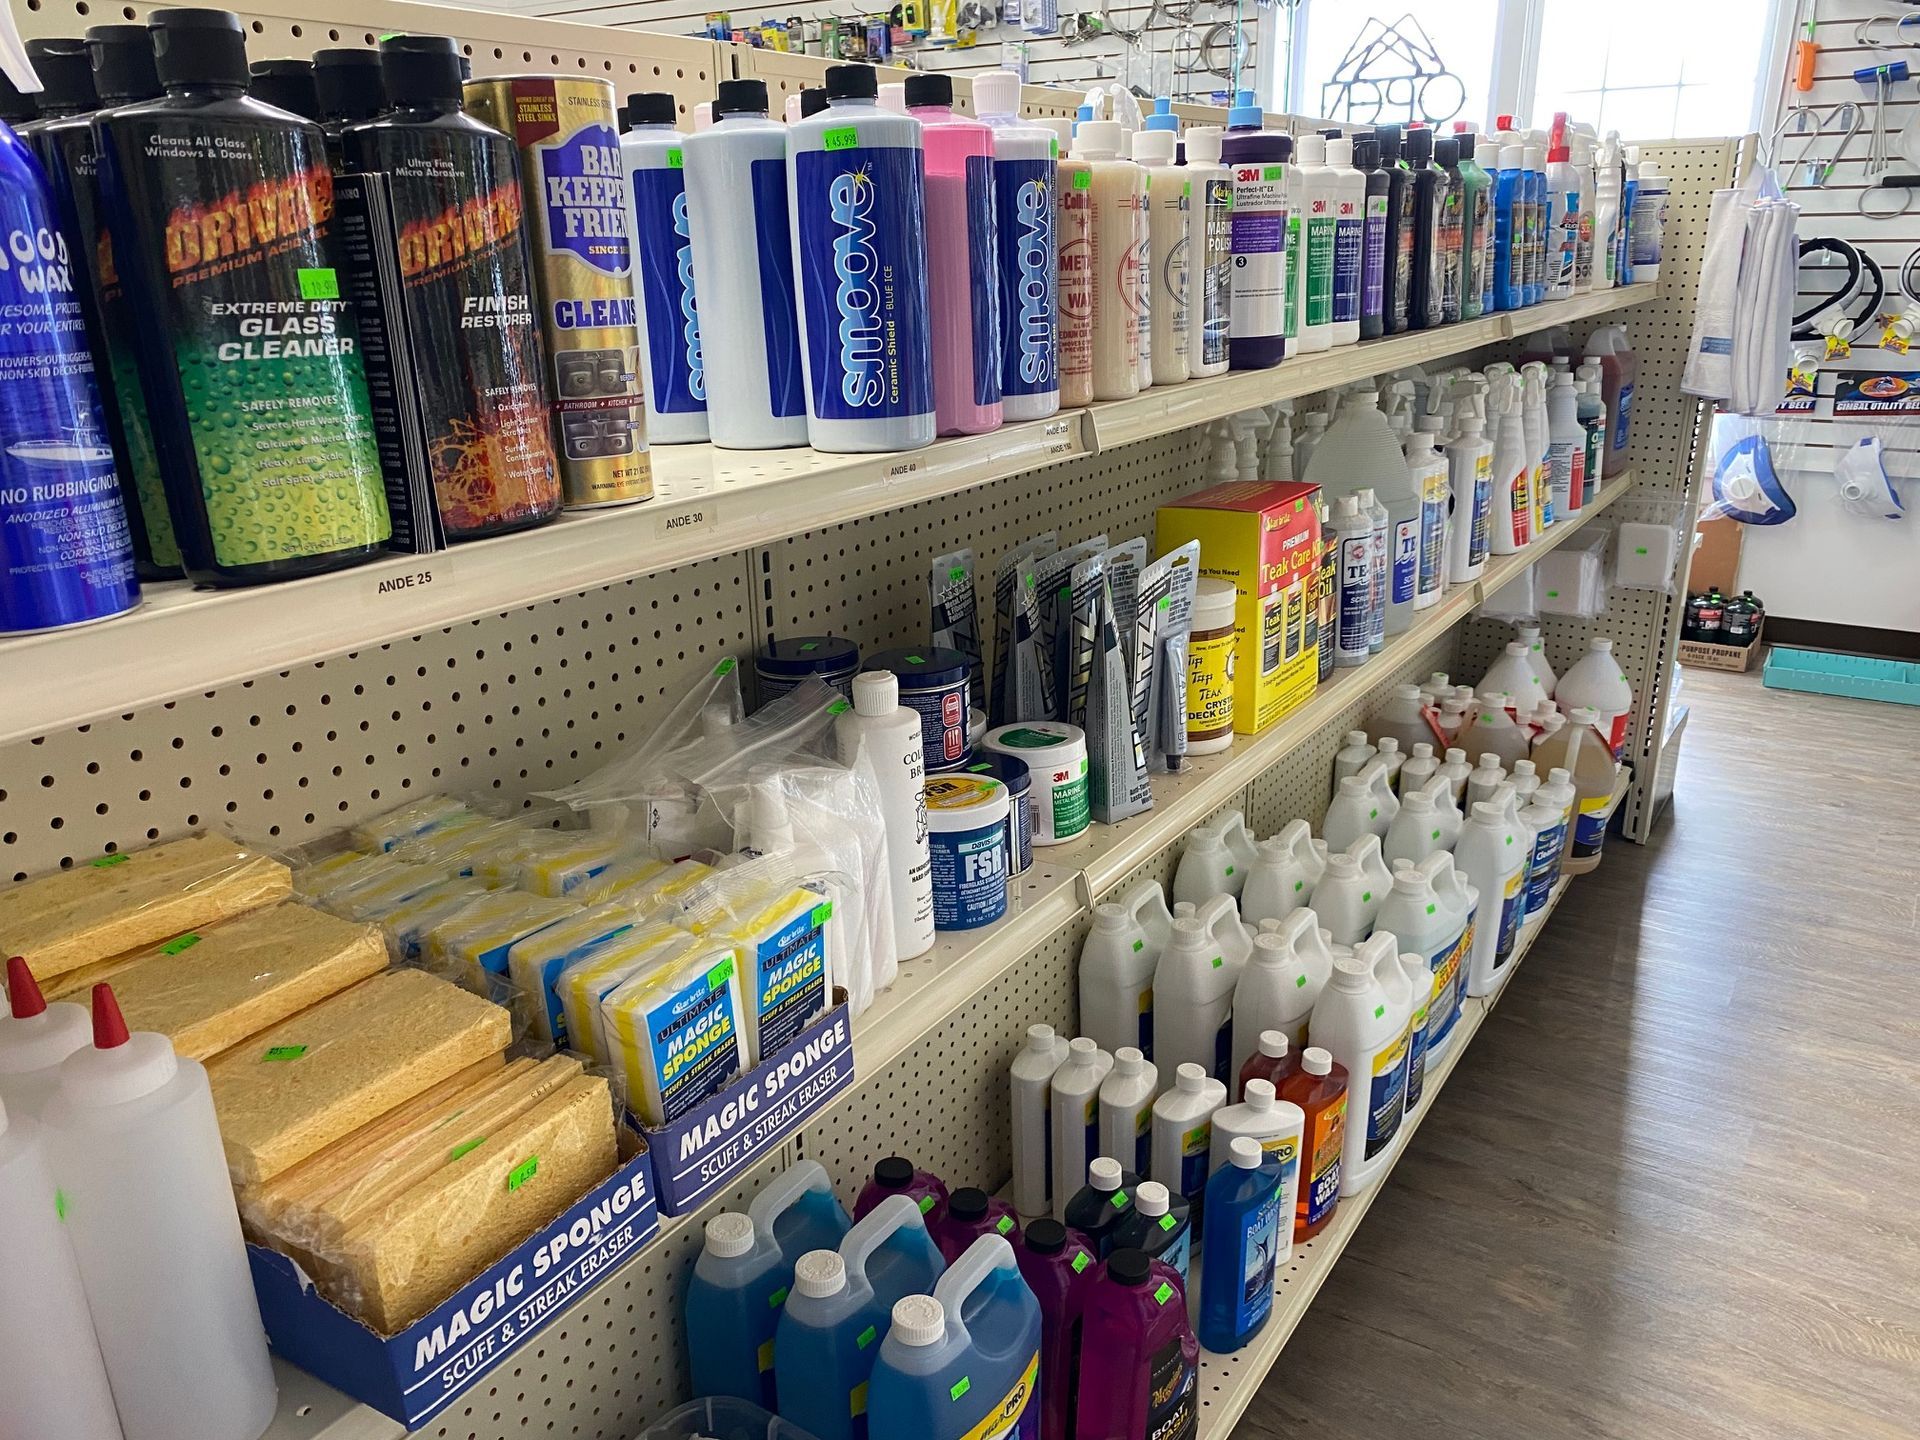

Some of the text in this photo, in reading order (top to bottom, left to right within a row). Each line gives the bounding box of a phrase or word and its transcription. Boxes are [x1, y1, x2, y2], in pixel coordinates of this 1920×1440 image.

[520, 104, 552, 113] STAINLESS
[568, 97, 600, 108] STAINLESS
[517, 113, 556, 122] STEEL SINKS
[150, 135, 246, 149] Cleans All Glass
[145, 147, 252, 161] Windows & Doors
[407, 158, 453, 168] Ultra Fine
[395, 167, 465, 178] Micro Abrasive
[1237, 168, 1260, 182] 3M
[1312, 200, 1327, 213] 3M
[1340, 203, 1354, 214] 3M
[589, 245, 619, 255] SINCE
[173, 238, 300, 289] PREMIUM ACID
[20, 265, 73, 294] WAX
[1017, 181, 1050, 383] smoove
[829, 173, 887, 408] smoove
[211, 301, 346, 316] EXTREME DUTY
[463, 295, 529, 313] FINISH
[16, 322, 53, 335] YOUR
[239, 316, 336, 338] GLASS
[461, 312, 532, 329] RESTORER
[883, 265, 899, 405] Ceramic Shield BLUE ICE
[218, 338, 354, 361] CLEANER
[485, 386, 510, 397] SAFELY
[241, 395, 338, 412] SAFELY REMOVES
[564, 401, 598, 410] BATHROOM
[1789, 401, 1812, 410] BELT
[1836, 401, 1904, 411] GIMBAL UTILITY
[252, 421, 288, 432] Severe
[291, 416, 316, 428] Hard
[612, 470, 624, 479] NET
[890, 463, 916, 476] ANDE 40
[0, 488, 28, 506] NO
[5, 508, 69, 525] ANODIZED
[666, 512, 703, 530] ANDE 30
[1208, 568, 1222, 576] You
[1262, 548, 1311, 584] Teak Care
[378, 571, 432, 594] ANDE 25
[1288, 602, 1301, 616] Teak
[1265, 613, 1280, 628] Teak
[1188, 710, 1215, 720] DECK
[1052, 771, 1069, 783] 3M
[1054, 785, 1081, 799] MARINE
[965, 845, 1002, 882] FSR
[765, 929, 819, 969] ULTIMATE
[768, 943, 816, 988] MAGIC
[763, 955, 821, 1009] SPONGE
[761, 1008, 778, 1025] SCUFF
[784, 990, 805, 1009] STREAK
[804, 977, 824, 995] ERASER
[660, 988, 723, 1041] ULTIMATE
[667, 1003, 723, 1060] MAGIC
[662, 1015, 731, 1081] SPONGE
[665, 1037, 735, 1098] SCUFF & STREAK ERASER
[679, 1083, 759, 1161] MAGIC
[765, 1019, 846, 1098] SPONGE
[700, 1067, 838, 1182] SCUFF & STREAK ERASER
[413, 1171, 647, 1372] MAGIC SPONGE
[442, 1226, 634, 1389] SCUFF & STREAK ERASER
[1005, 1384, 1025, 1416] PRO
[1152, 1401, 1185, 1440] BOAT
